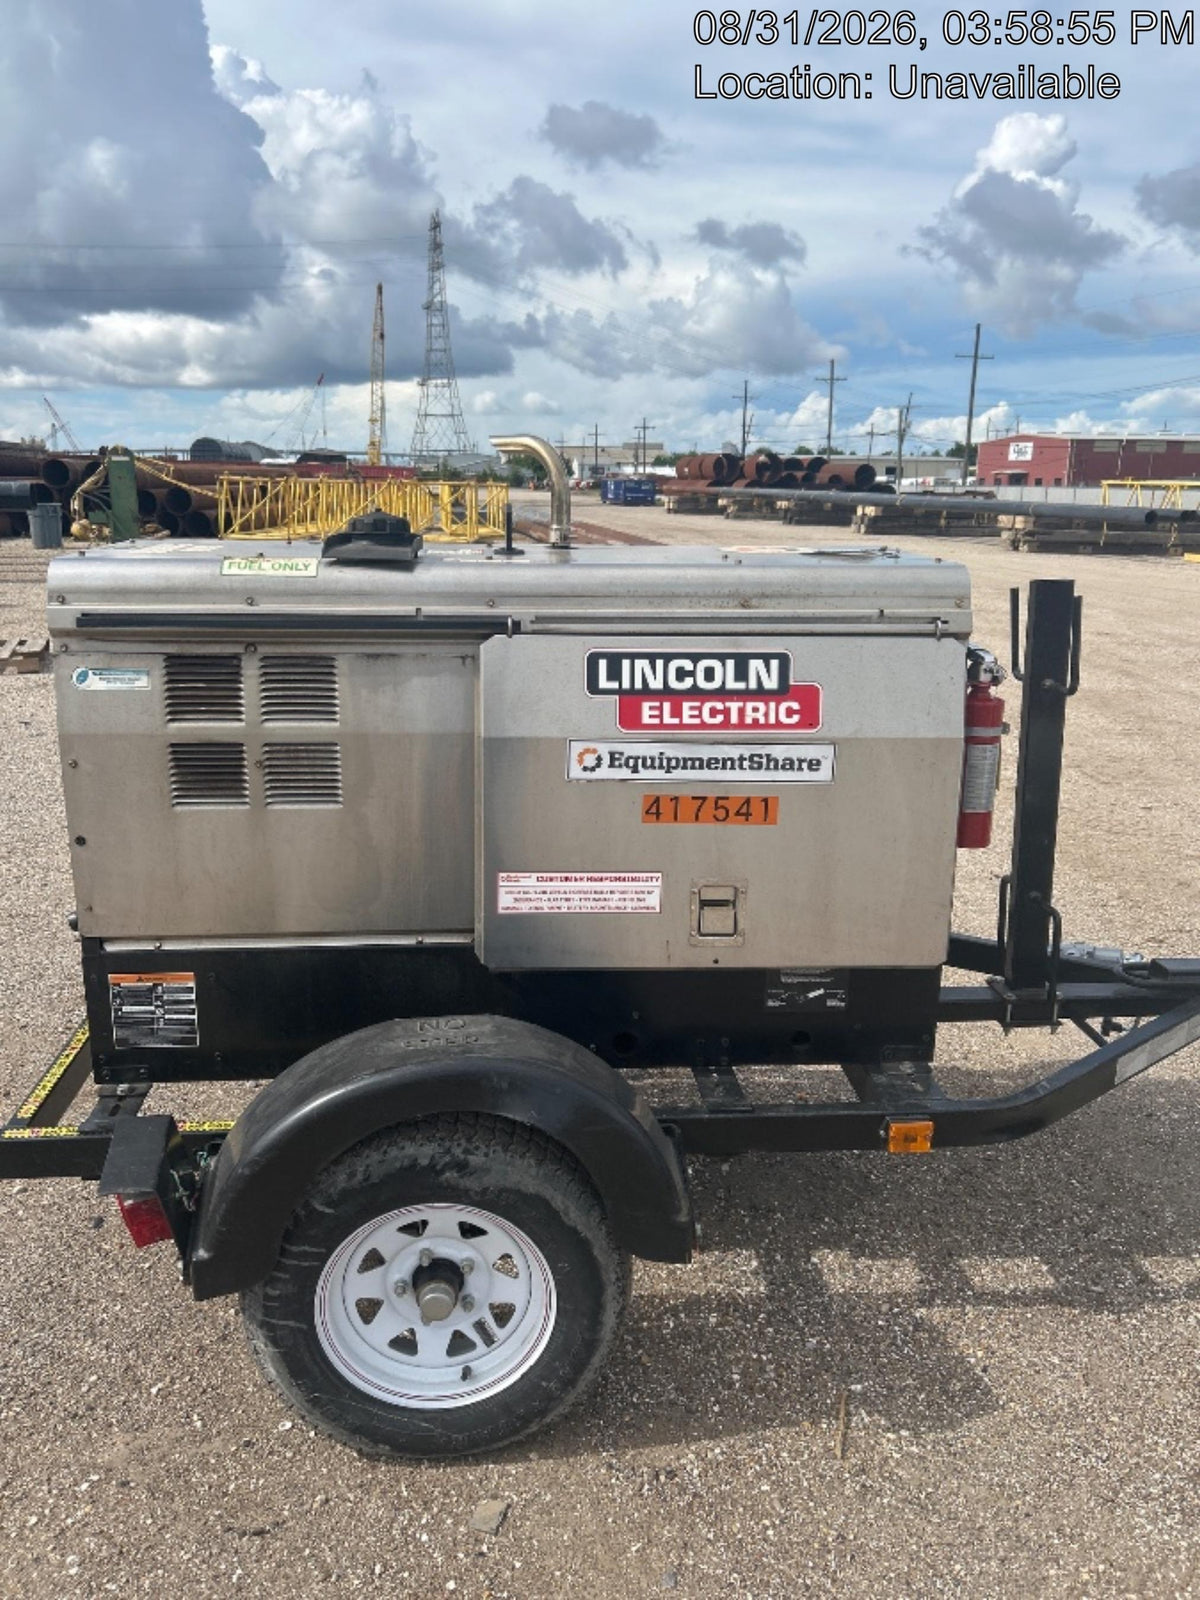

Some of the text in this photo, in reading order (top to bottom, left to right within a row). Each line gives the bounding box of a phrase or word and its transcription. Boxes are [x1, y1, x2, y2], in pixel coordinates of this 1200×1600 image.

[228, 561, 312, 571] FUEL ONLY
[598, 658, 780, 690] LINCOLN
[641, 701, 801, 725] ELECTRIC
[607, 751, 822, 774] EquipmentShare
[644, 796, 770, 823] 417541
